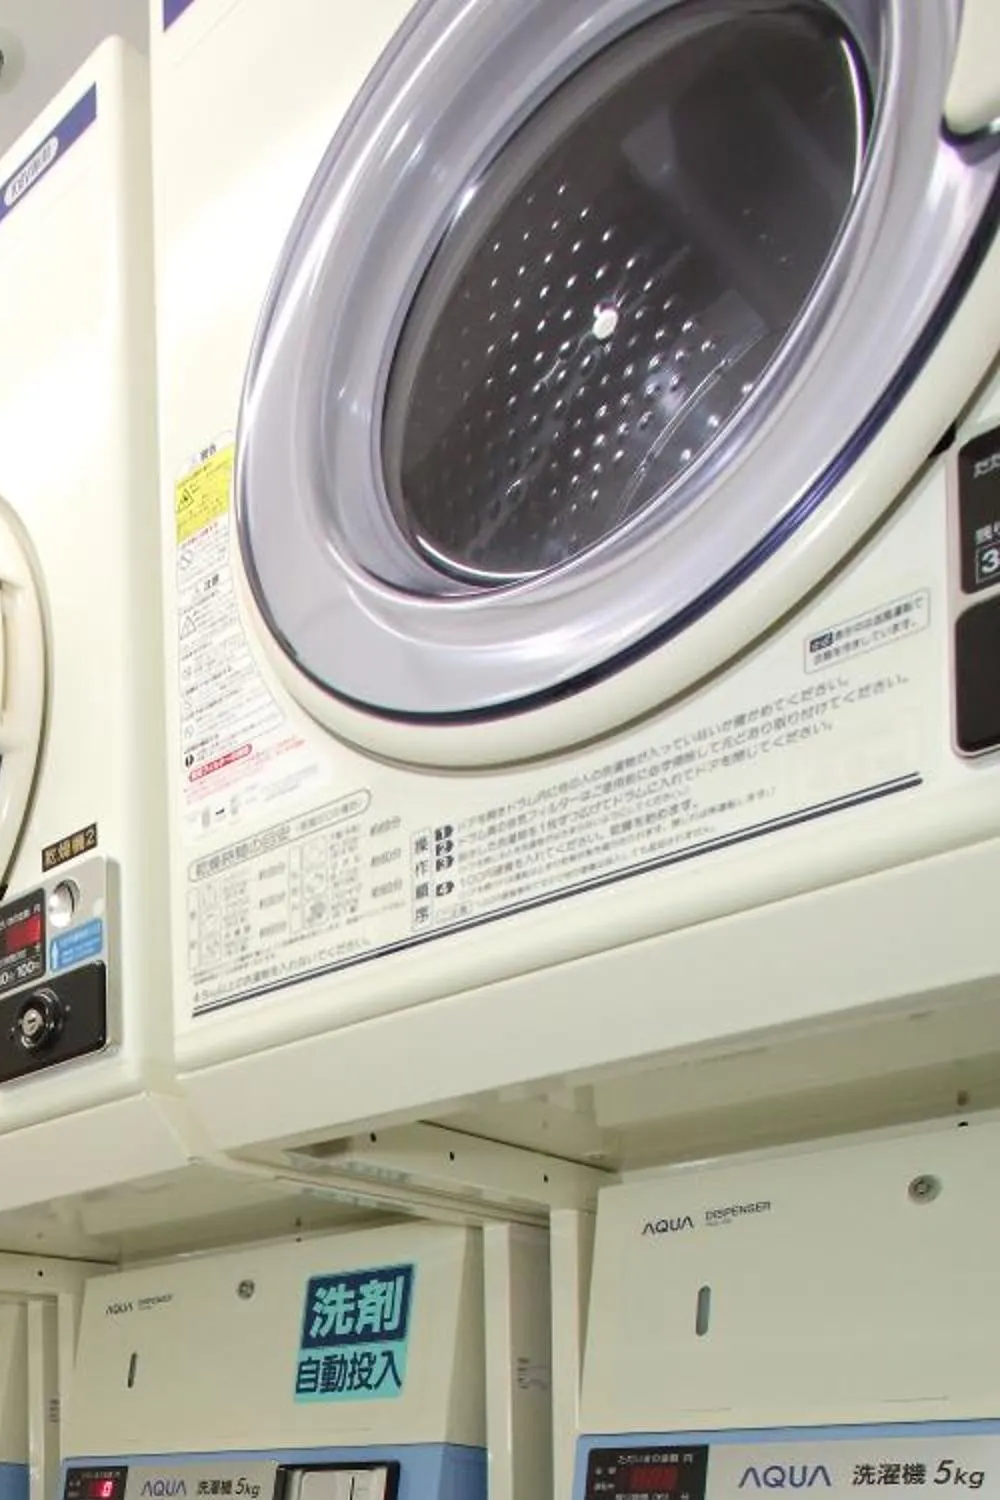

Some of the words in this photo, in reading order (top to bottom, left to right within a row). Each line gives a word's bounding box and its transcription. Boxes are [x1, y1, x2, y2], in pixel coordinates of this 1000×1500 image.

[641, 1215, 695, 1236] AQUA
[704, 1201, 771, 1221] DISPENSER
[310, 1273, 405, 1339] 洗剤
[295, 1349, 404, 1395] 自動投入
[140, 1475, 188, 1497] AQUA
[197, 1479, 233, 1496] 洗濯機
[235, 1477, 262, 1498] 5kg
[738, 1465, 832, 1489] AQUA
[852, 1463, 927, 1486] 洗濯機
[934, 1460, 986, 1490] 5kg
